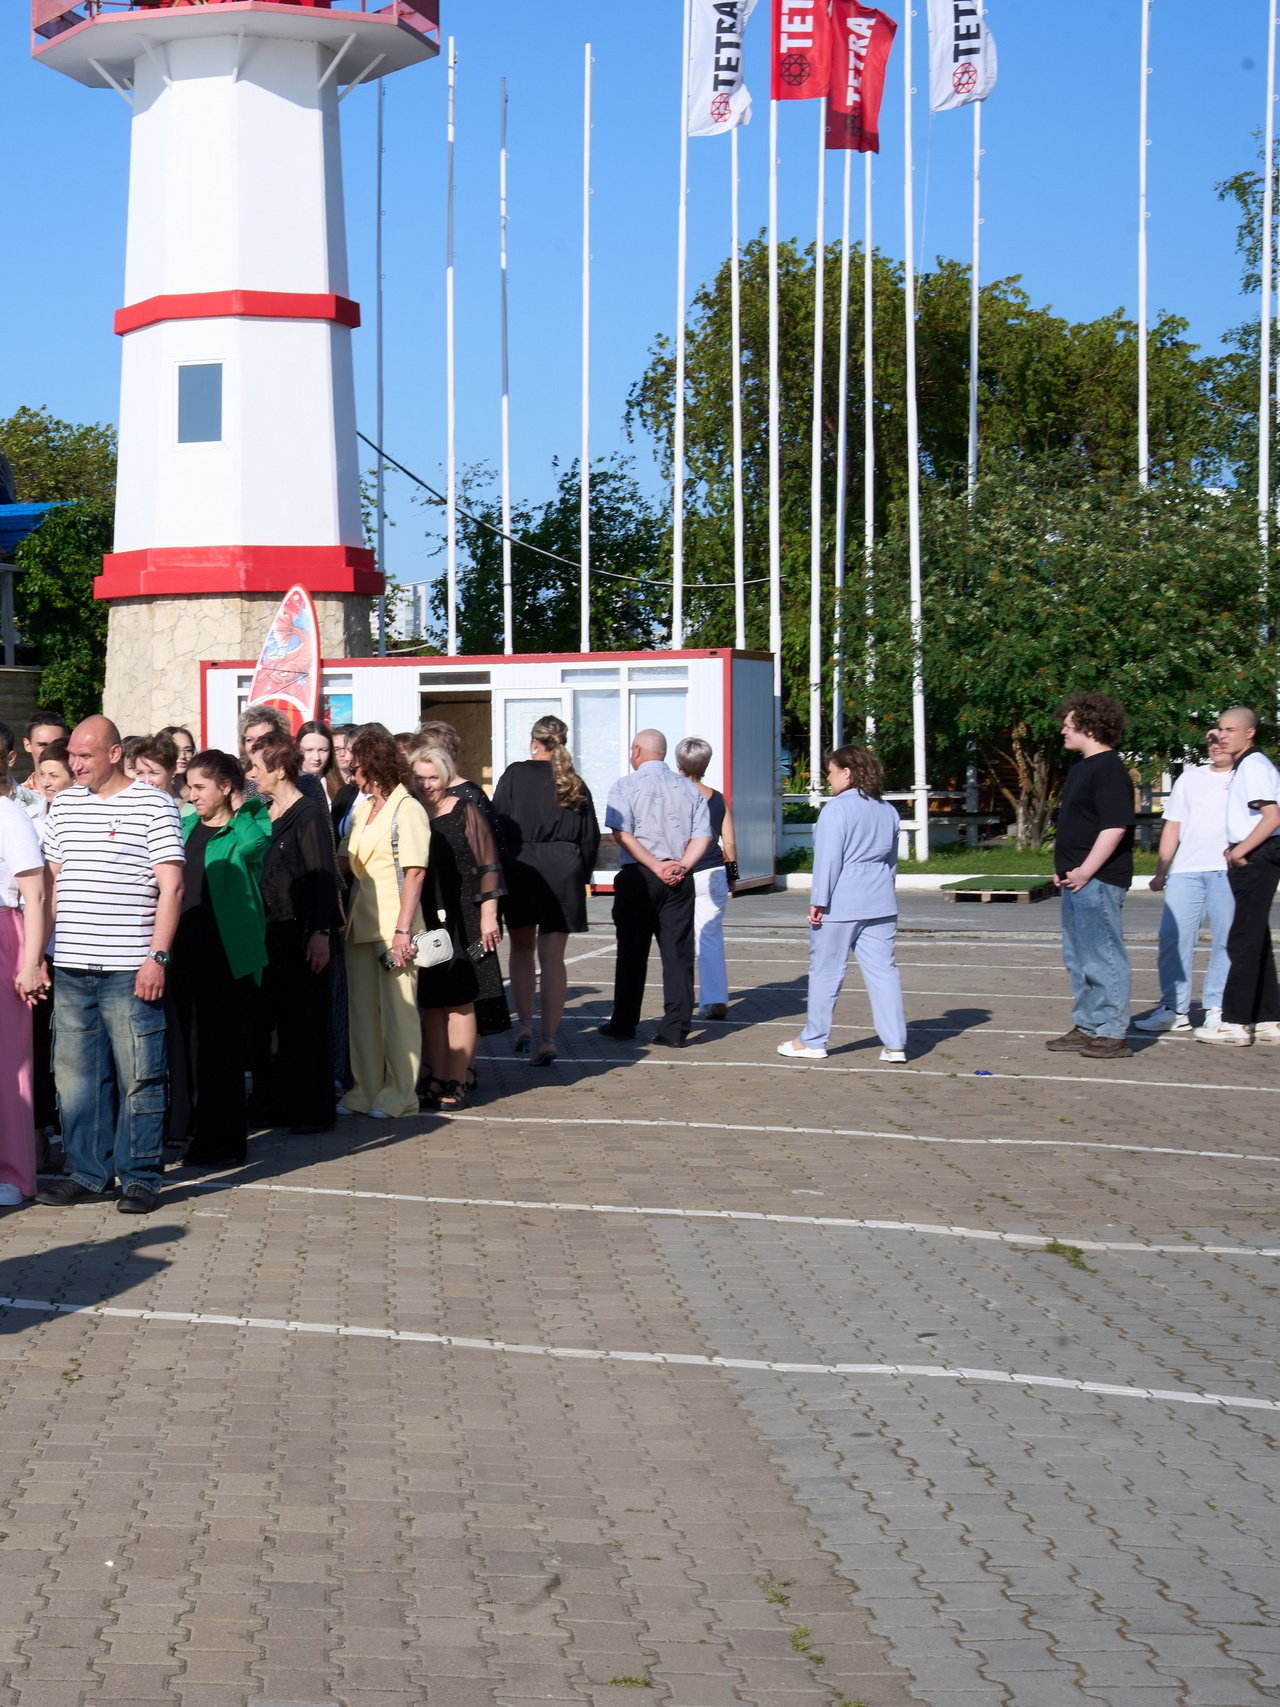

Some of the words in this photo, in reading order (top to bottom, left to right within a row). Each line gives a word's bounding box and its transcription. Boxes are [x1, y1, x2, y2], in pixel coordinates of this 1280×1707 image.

[713, 2, 740, 91] TETRA
[846, 17, 876, 106] TETRA
[953, 0, 980, 63] TET
